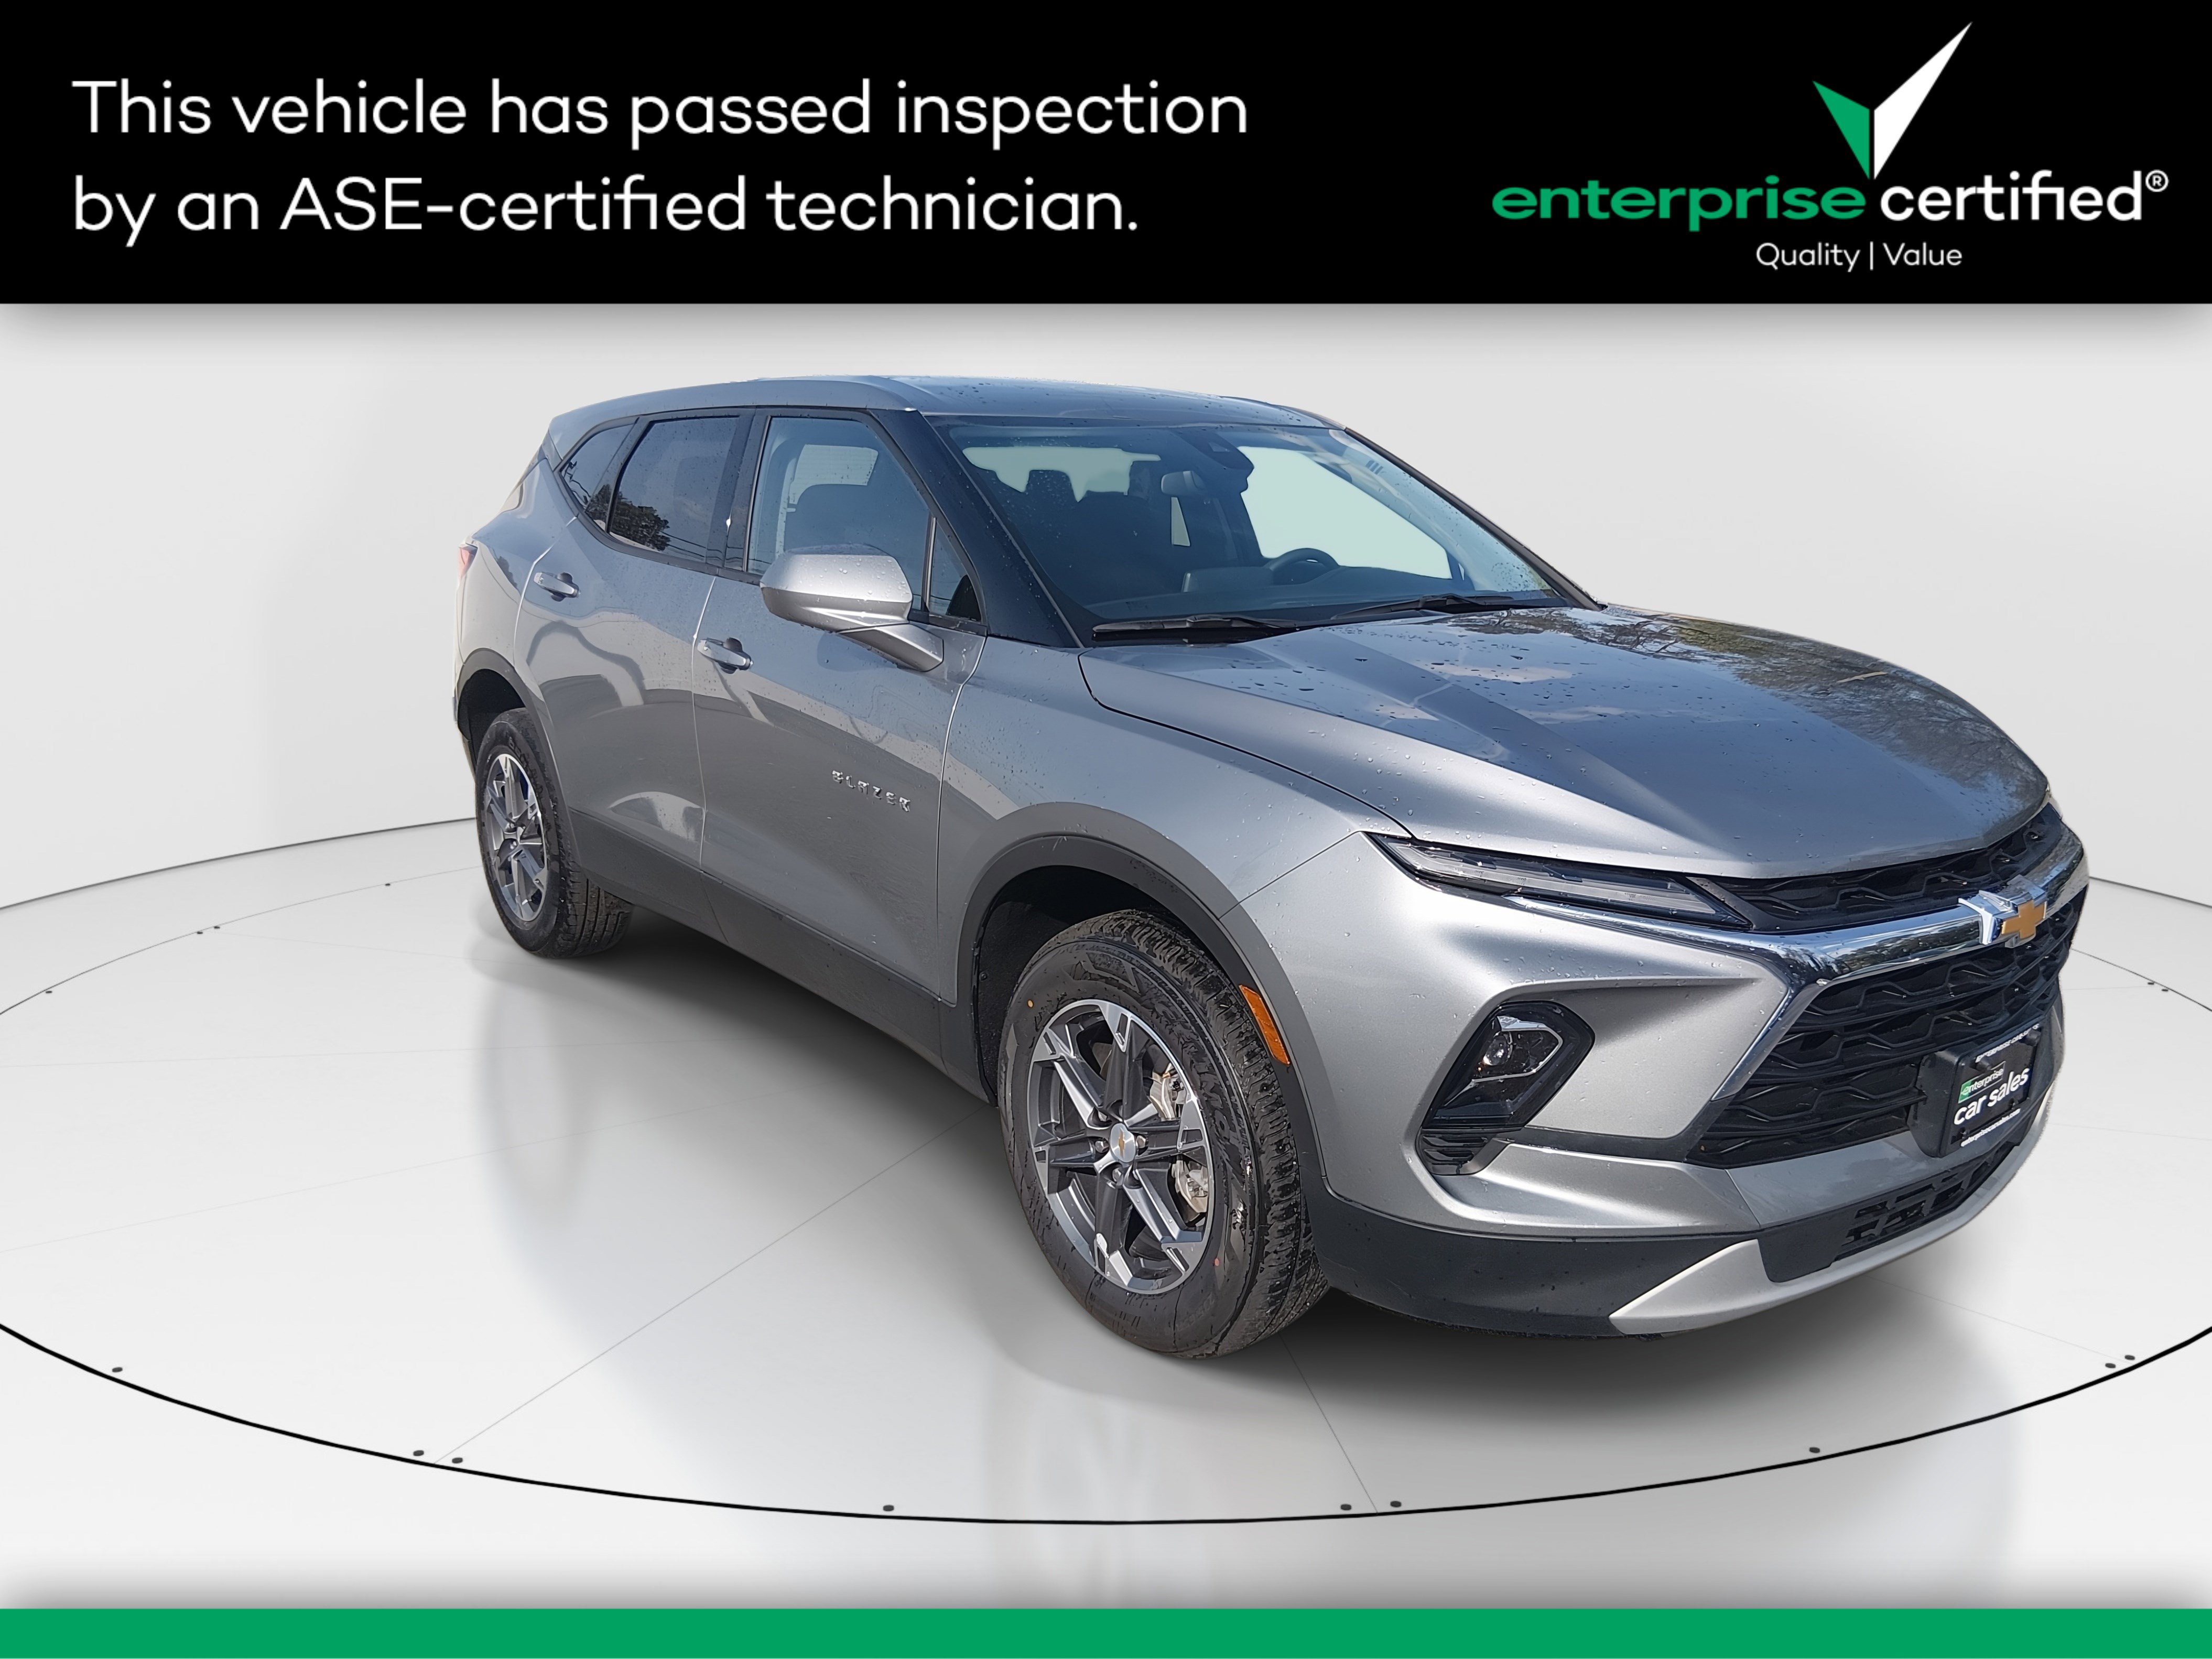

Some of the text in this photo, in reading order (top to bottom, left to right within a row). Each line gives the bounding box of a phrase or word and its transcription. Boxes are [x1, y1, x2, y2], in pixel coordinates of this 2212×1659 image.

[832, 770, 911, 812] BLAZER
[1954, 1068, 2030, 1125] car sales
[1961, 1068, 2003, 1096] enterprise
